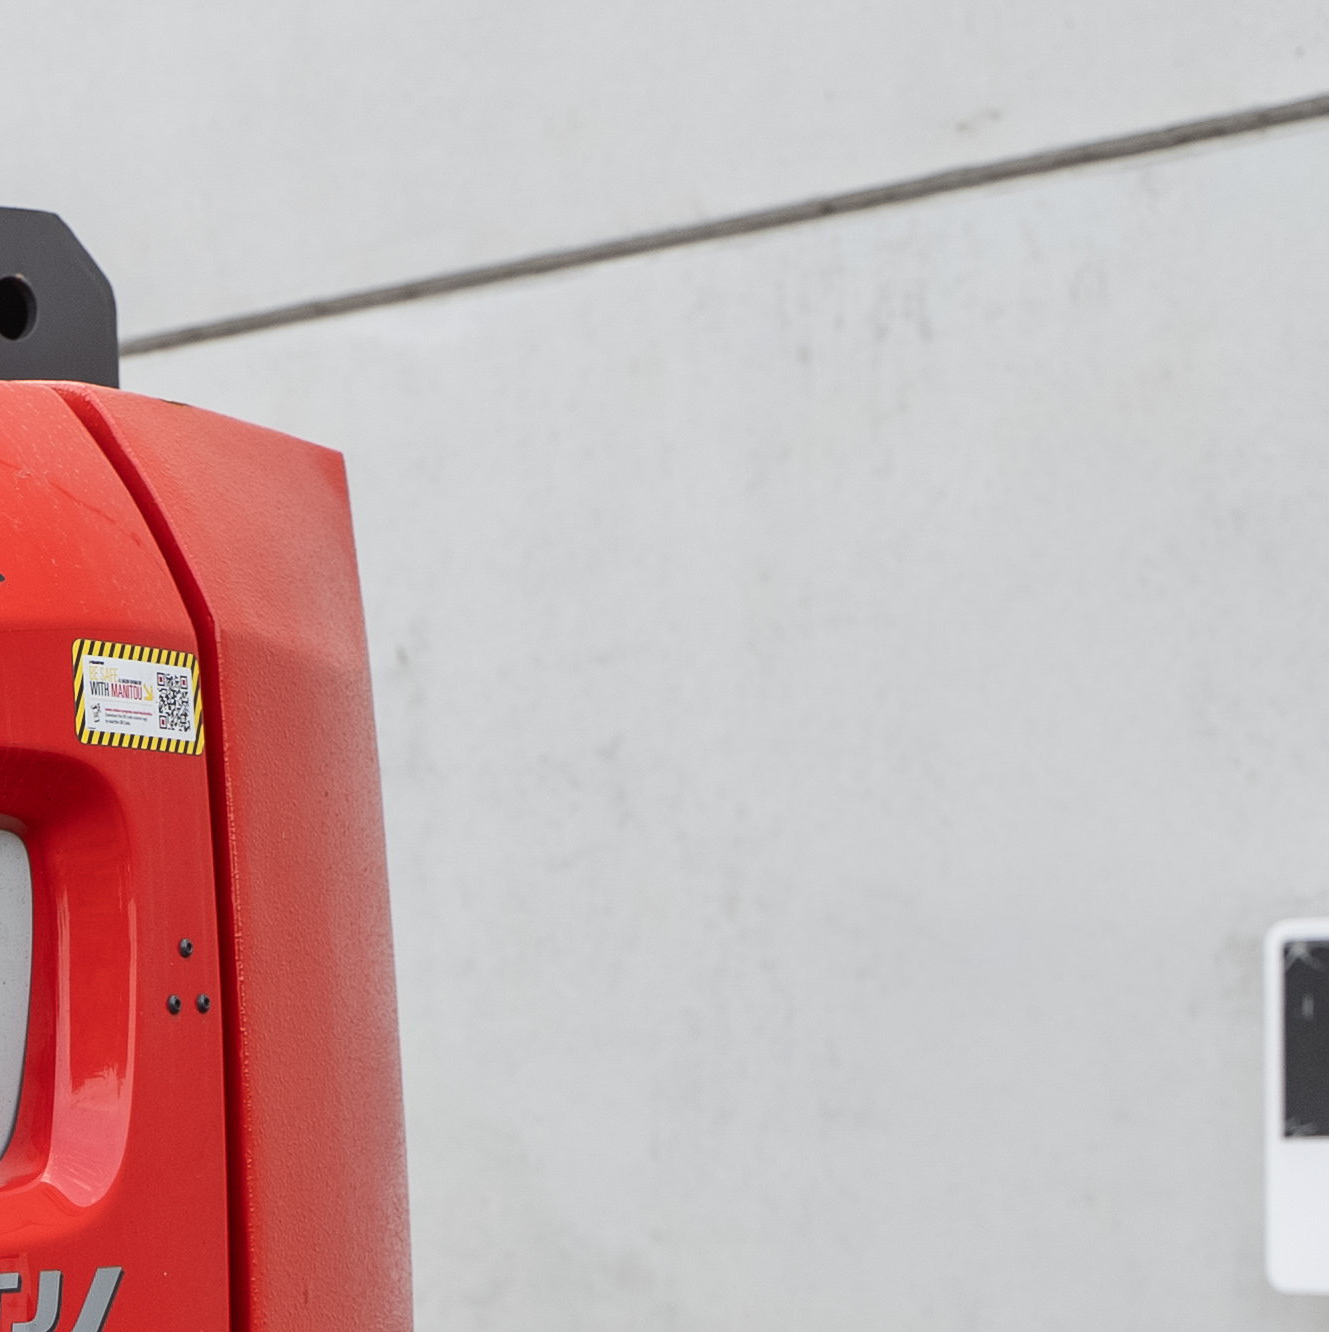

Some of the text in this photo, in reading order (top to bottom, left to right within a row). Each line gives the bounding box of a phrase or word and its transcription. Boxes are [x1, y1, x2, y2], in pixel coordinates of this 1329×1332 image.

[99, 667, 118, 683] SAFE
[90, 681, 110, 697] WITH
[111, 683, 143, 701] MANITOU
